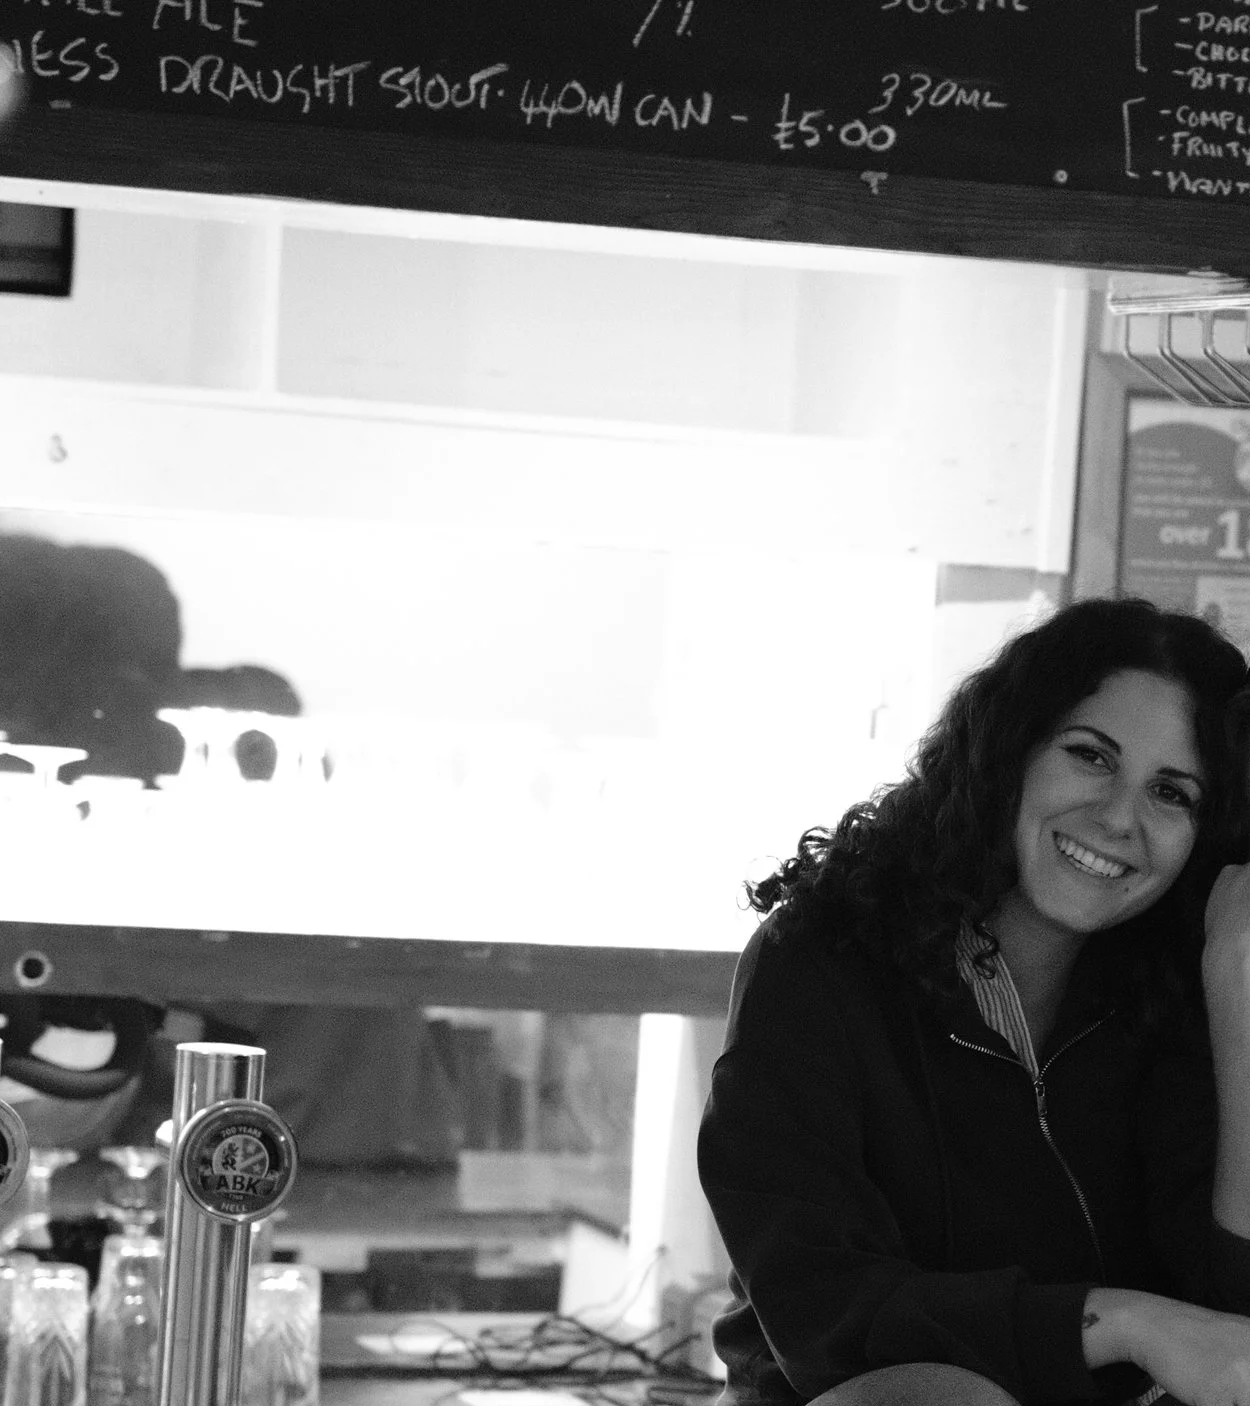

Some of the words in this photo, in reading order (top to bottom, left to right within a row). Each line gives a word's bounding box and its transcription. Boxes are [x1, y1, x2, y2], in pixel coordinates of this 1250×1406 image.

[159, 54, 372, 113] DRAUGHT
[633, 91, 713, 132] CAN
[216, 1174, 262, 1195] ABK
